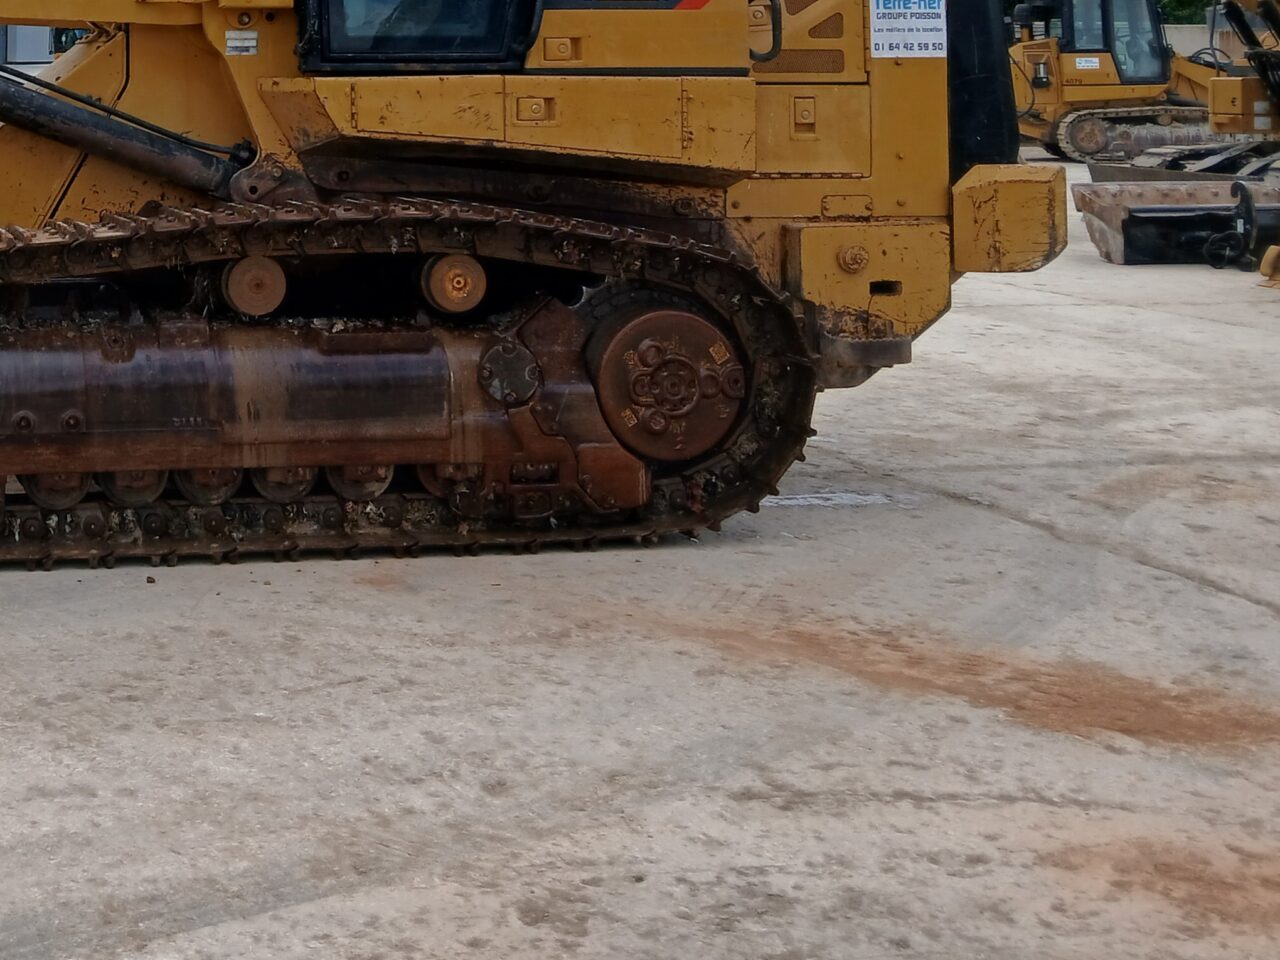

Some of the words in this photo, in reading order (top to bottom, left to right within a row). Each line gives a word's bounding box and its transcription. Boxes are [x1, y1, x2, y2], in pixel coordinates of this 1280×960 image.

[876, 12, 908, 20] GROUPE
[909, 12, 942, 20] POISSON
[874, 42, 884, 51] 01
[888, 42, 900, 51] 64
[903, 42, 915, 52] 42
[917, 42, 929, 51] 59
[931, 42, 943, 51] 50
